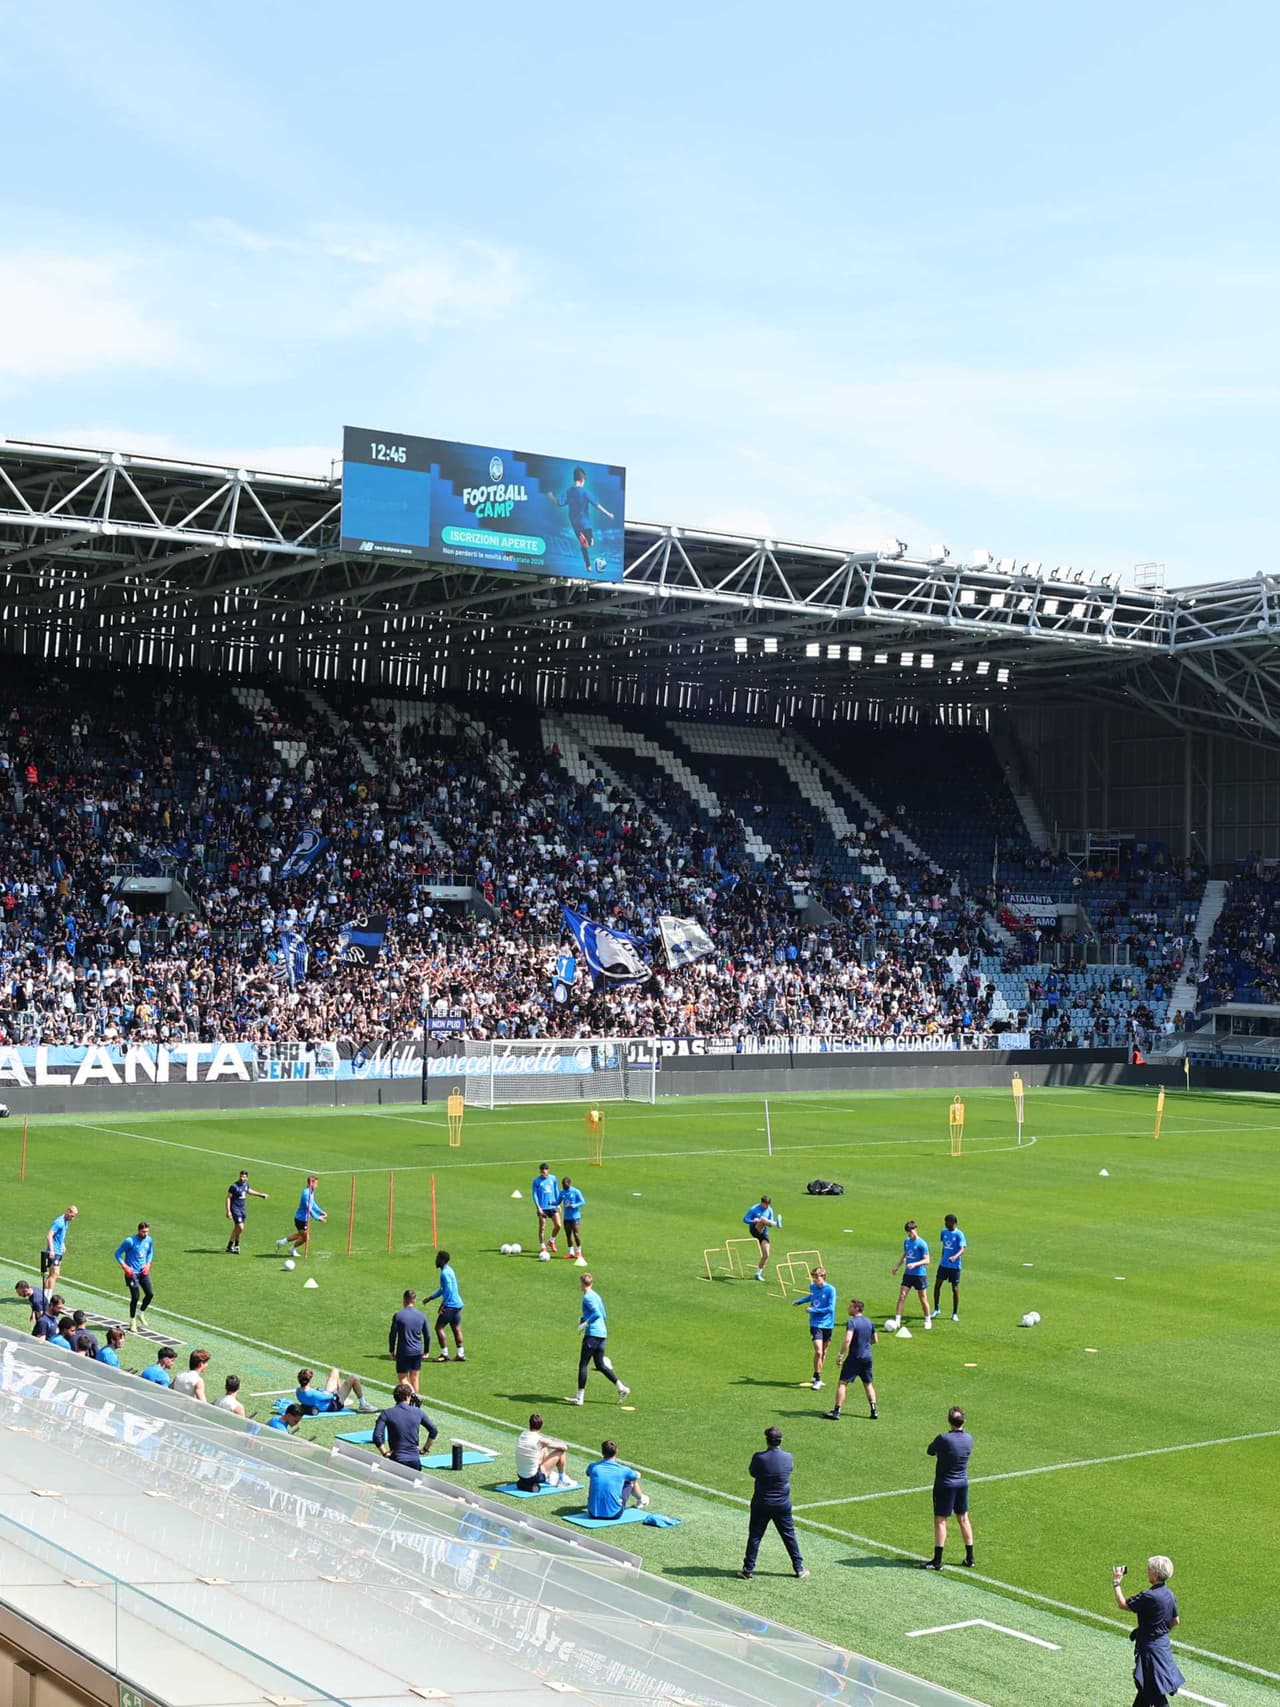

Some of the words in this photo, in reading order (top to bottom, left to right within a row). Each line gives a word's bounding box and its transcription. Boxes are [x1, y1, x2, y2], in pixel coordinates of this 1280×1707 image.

[370, 443, 407, 463] 12:45
[463, 484, 528, 506] FOOTBALL
[475, 500, 514, 518] CAMP
[450, 530, 500, 546] ISCRIZIONI
[501, 537, 539, 551] APERTE
[455, 549, 478, 557] perderti
[1010, 895, 1053, 904] ATALANTA
[824, 1036, 882, 1053] VECCHIA
[896, 1034, 953, 1051] GUARDIA
